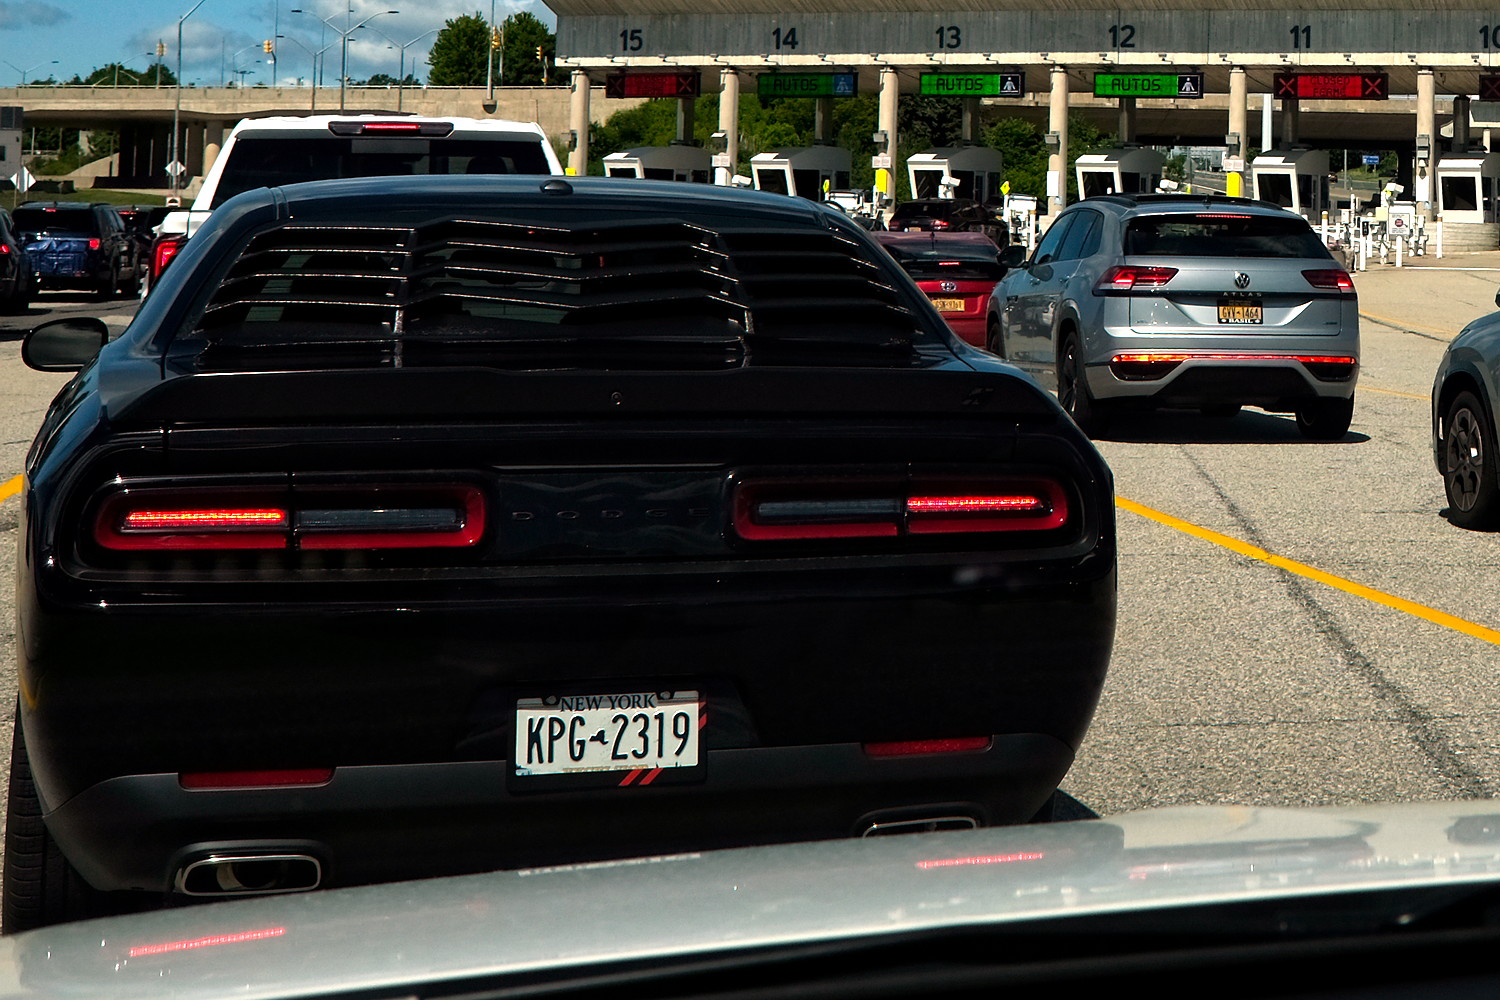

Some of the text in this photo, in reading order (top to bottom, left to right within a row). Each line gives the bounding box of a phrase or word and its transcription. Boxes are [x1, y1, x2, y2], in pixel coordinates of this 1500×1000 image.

[619, 29, 643, 51] 15
[772, 27, 799, 50] 14
[935, 26, 962, 49] 13
[1108, 25, 1136, 48] 12
[1290, 25, 1311, 49] 11
[773, 78, 819, 91] AUTOS
[936, 78, 984, 91] AUTOS
[1111, 78, 1161, 91] AUTOS
[1310, 77, 1350, 85] CLOSED
[511, 509, 710, 521] DODGE
[560, 693, 658, 712] NEW YORK
